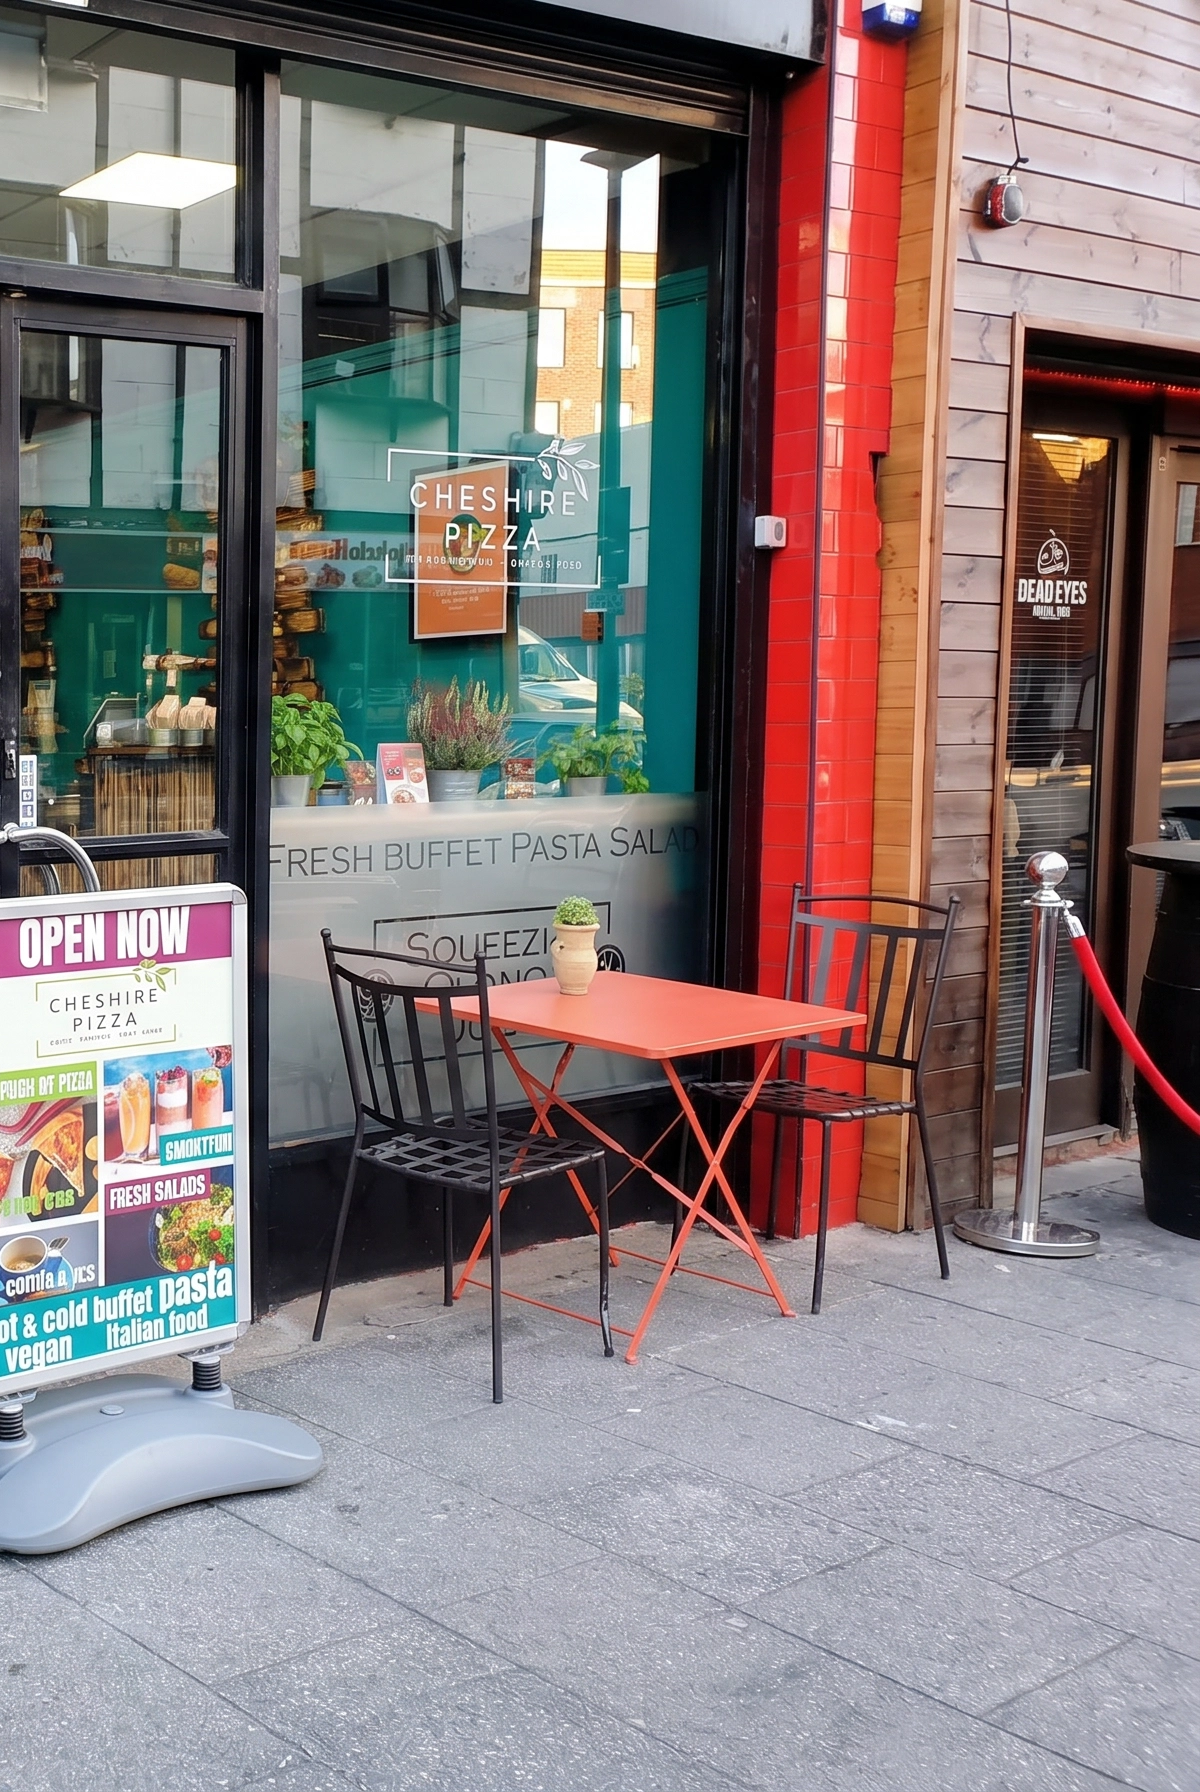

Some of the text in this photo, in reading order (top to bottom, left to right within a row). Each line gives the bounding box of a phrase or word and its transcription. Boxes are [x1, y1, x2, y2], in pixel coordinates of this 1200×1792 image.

[409, 482, 577, 517] CHESHIRE
[445, 522, 541, 552] PIZZA
[1017, 578, 1088, 605] DEAD EYES
[269, 827, 699, 877] FRESH BUFFET PASTA SALAD
[19, 905, 191, 969] OPEN NOW
[406, 927, 557, 968] SQUEEZI
[49, 988, 159, 1013] CHESHIRE
[73, 1011, 138, 1033] PIZZA
[109, 1182, 152, 1210] FRESH
[154, 1174, 206, 1202] SALADS
[22, 1313, 38, 1338] &
[42, 1297, 88, 1333] cold
[93, 1285, 153, 1324] buffet
[158, 1259, 233, 1315] pasta
[106, 1306, 209, 1351] Italian food
[4, 1335, 73, 1373] vegan
